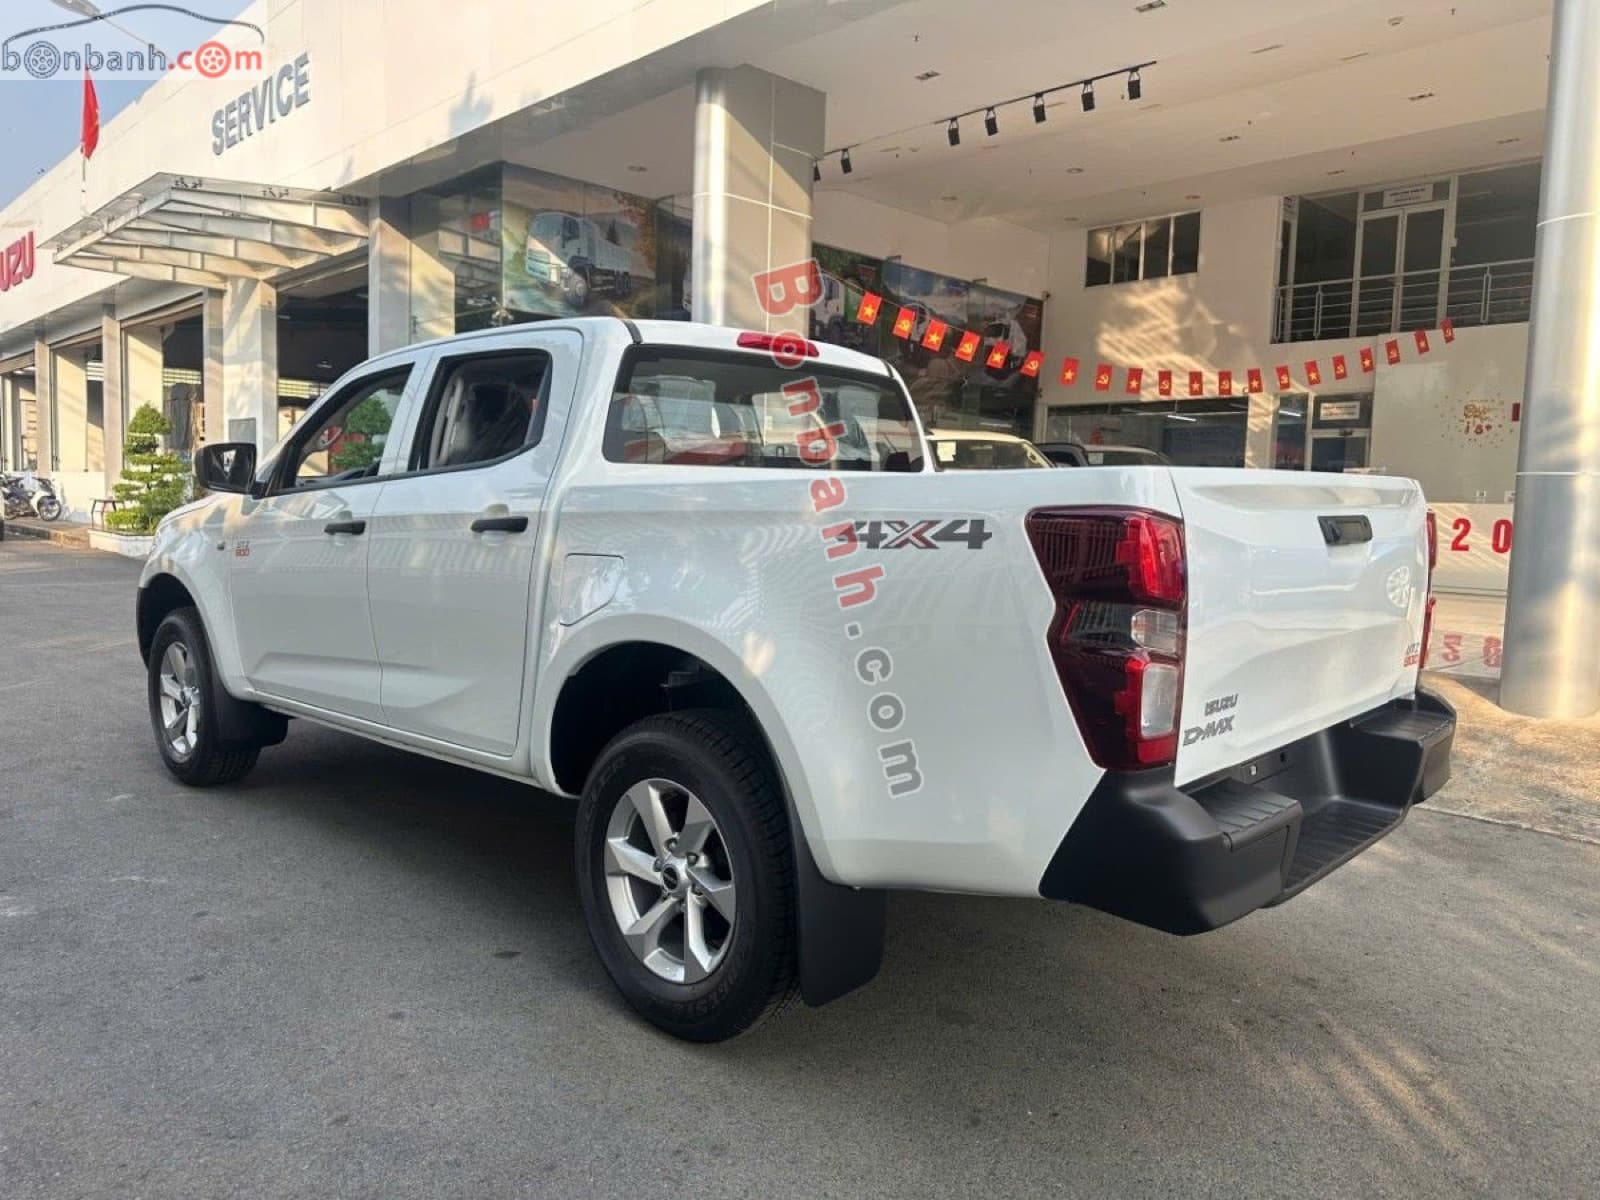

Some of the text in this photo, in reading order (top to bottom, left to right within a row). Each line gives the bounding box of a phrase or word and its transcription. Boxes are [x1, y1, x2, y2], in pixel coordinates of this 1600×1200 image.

[211, 53, 311, 156] SERVICE
[1204, 694, 1240, 717] ISUZU
[1183, 715, 1236, 747] D-MAX
